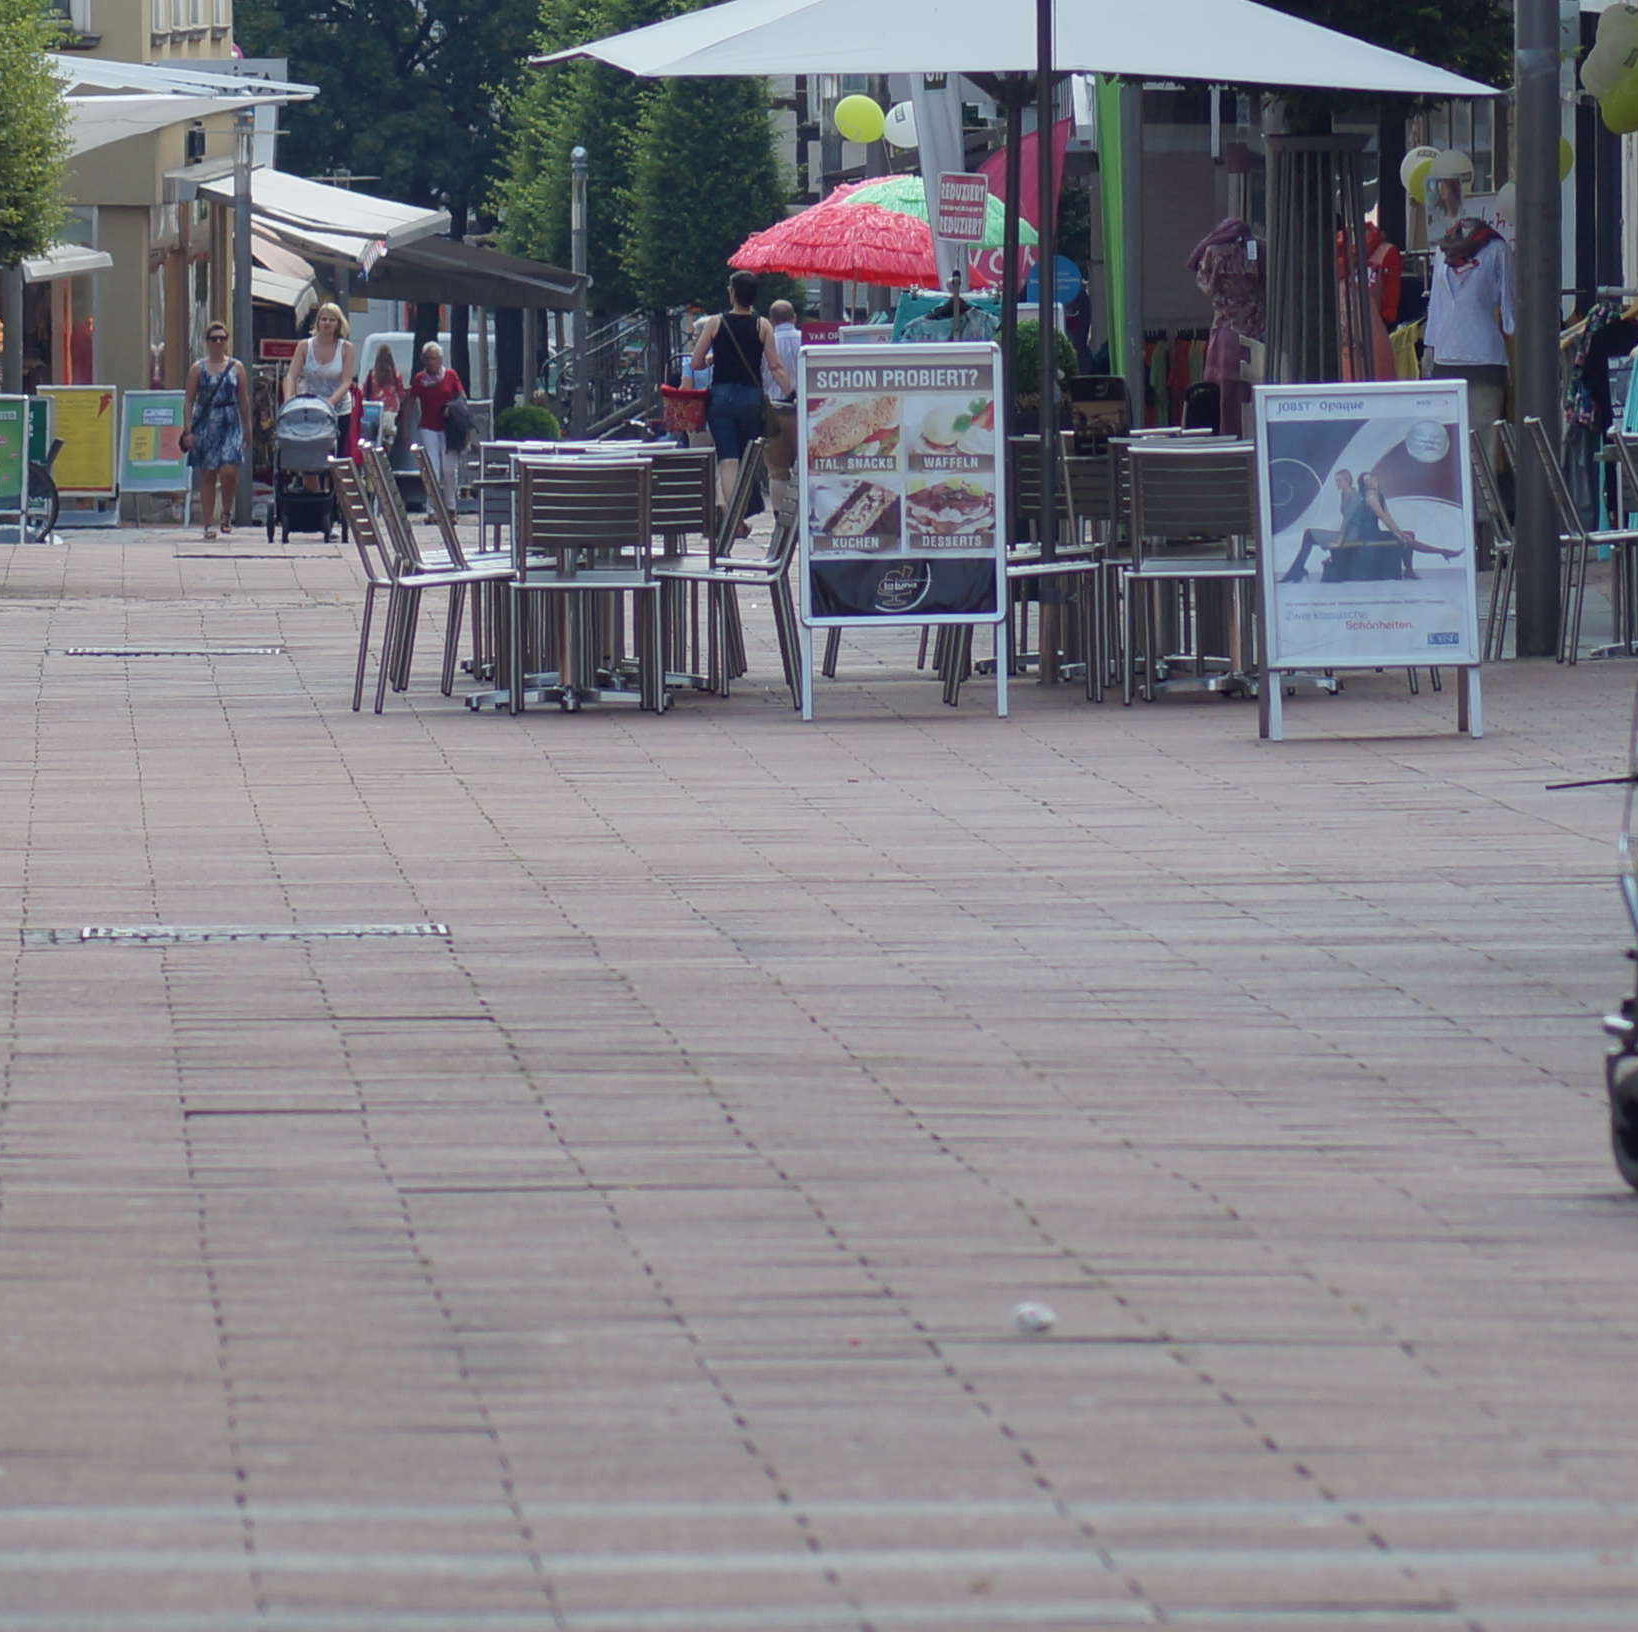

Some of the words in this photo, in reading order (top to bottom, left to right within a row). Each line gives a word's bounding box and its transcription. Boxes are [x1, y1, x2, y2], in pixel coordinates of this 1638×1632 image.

[816, 370, 877, 389] SCHON
[882, 369, 979, 387] PROBIERT?
[1319, 400, 1364, 413] Opaque
[847, 457, 894, 469] SNACKS
[923, 456, 979, 468] WAFFELN
[832, 536, 879, 549] KUCHEN
[922, 535, 982, 547] DESSERTS
